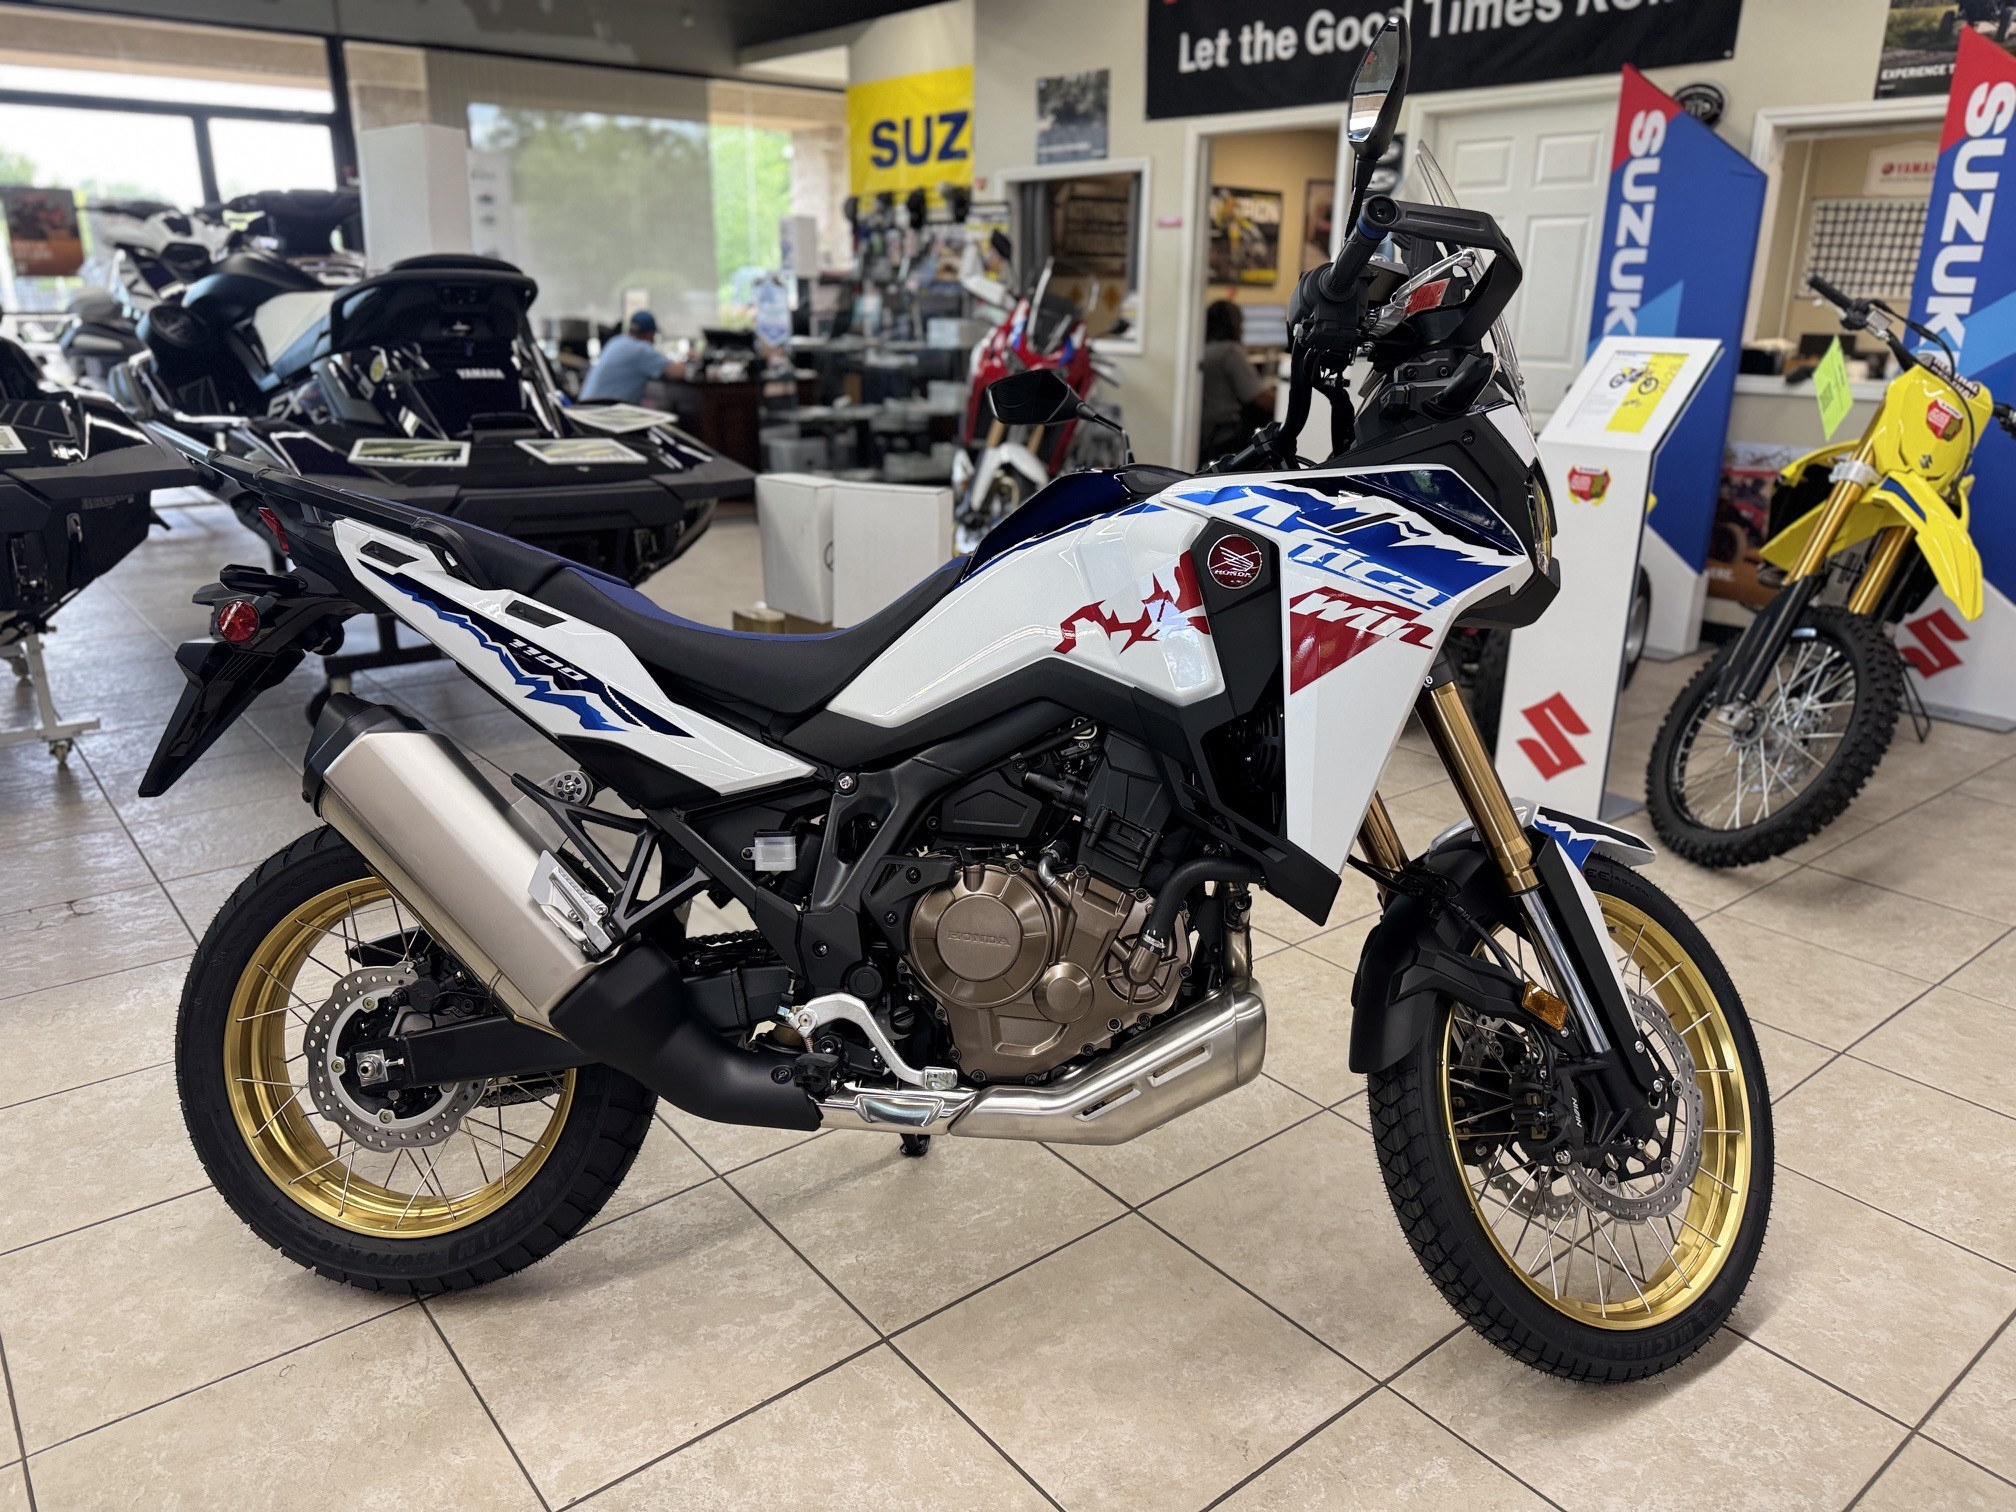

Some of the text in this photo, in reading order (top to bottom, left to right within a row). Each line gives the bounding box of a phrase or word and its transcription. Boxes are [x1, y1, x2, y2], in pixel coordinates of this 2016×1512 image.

[1178, 28, 1231, 74] Let
[1239, 19, 1299, 66] the
[1423, 0, 1564, 38] Times
[1881, 65, 1946, 81] EXPERIENCE
[455, 367, 506, 380] YAMAHA
[509, 638, 588, 681] 1100
[946, 930, 1011, 947] HONDA
